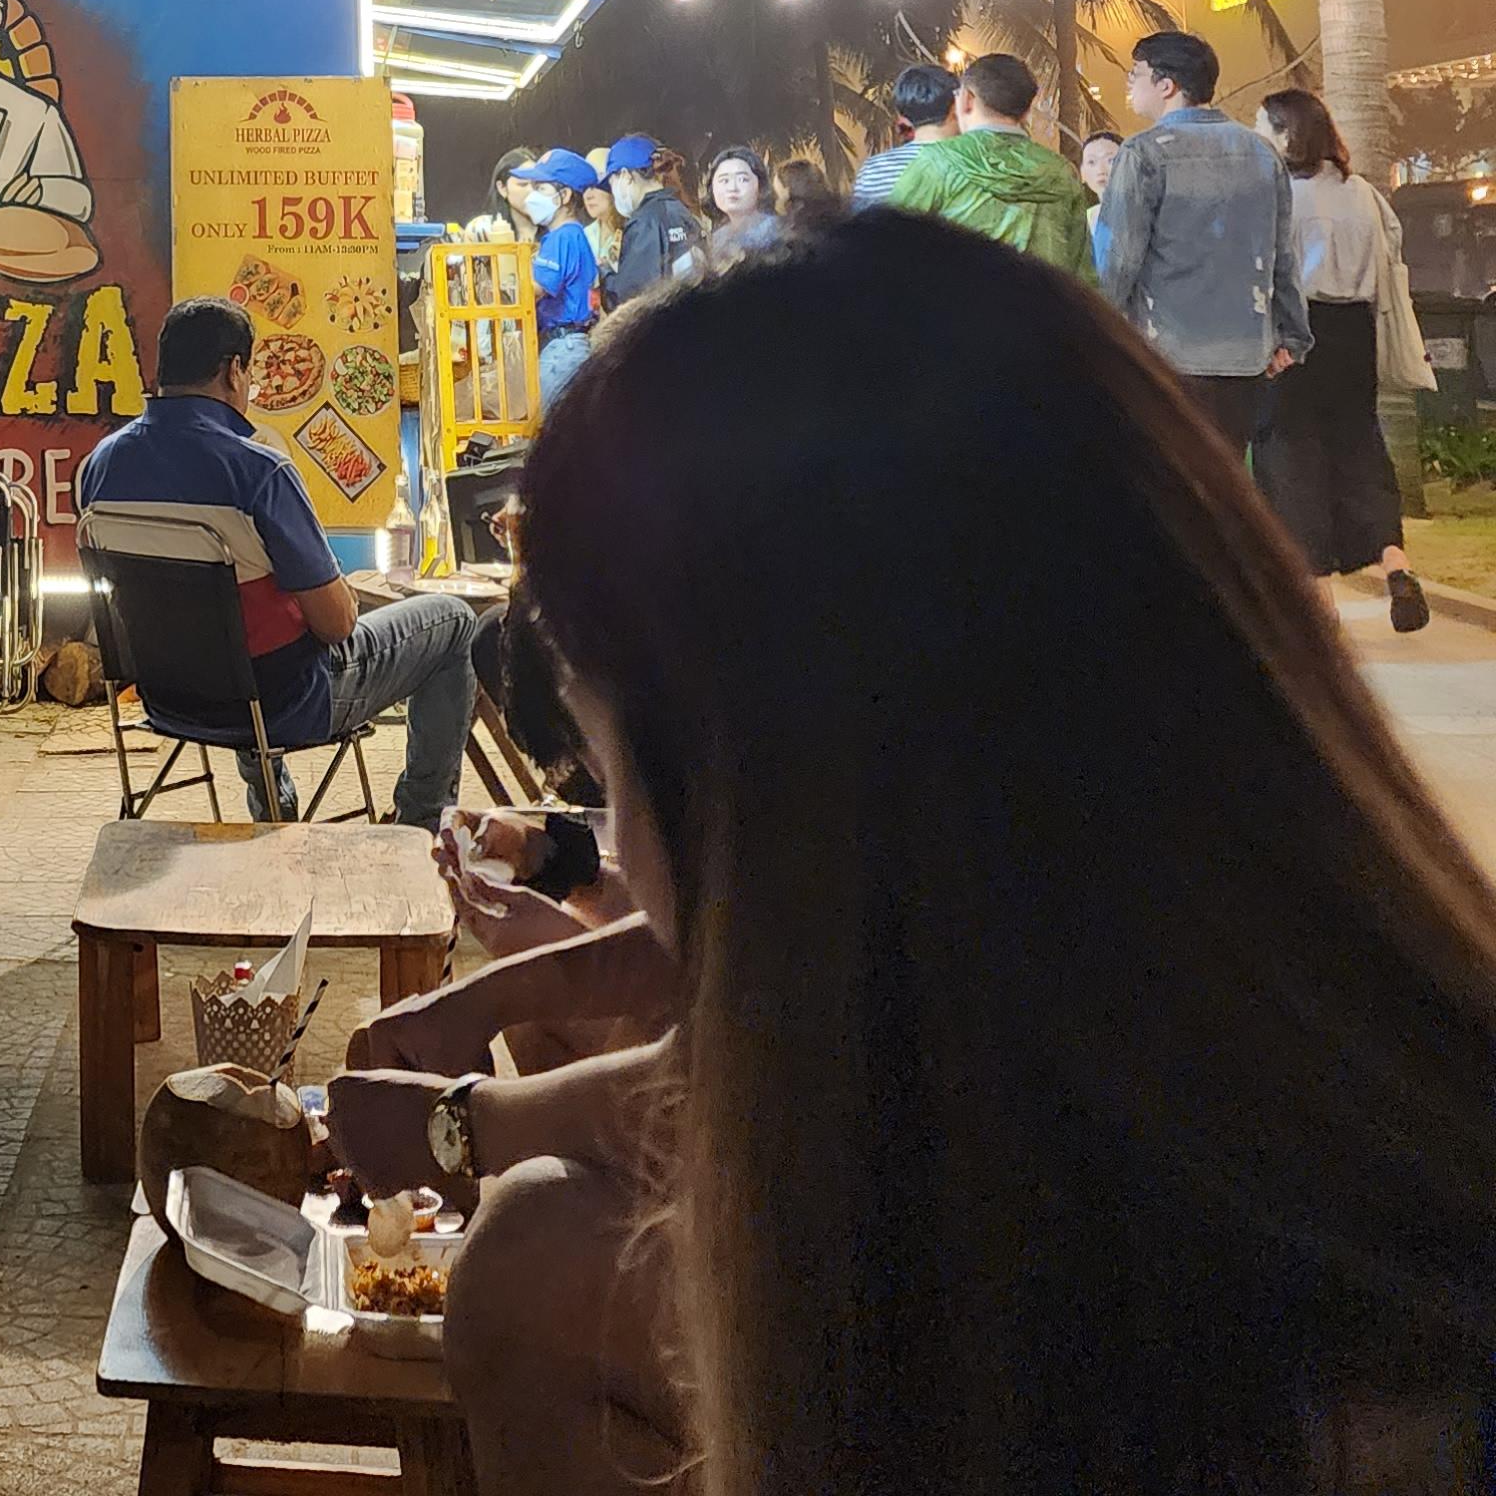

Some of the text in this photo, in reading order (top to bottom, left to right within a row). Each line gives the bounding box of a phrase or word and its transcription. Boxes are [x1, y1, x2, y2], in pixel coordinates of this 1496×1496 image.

[235, 127, 331, 143] HERBAL PIZZA
[245, 146, 321, 154] WOOD FIRED PIZZA
[189, 169, 380, 186] UNLIMITED BUFFET
[191, 195, 380, 241] ONLY 159K
